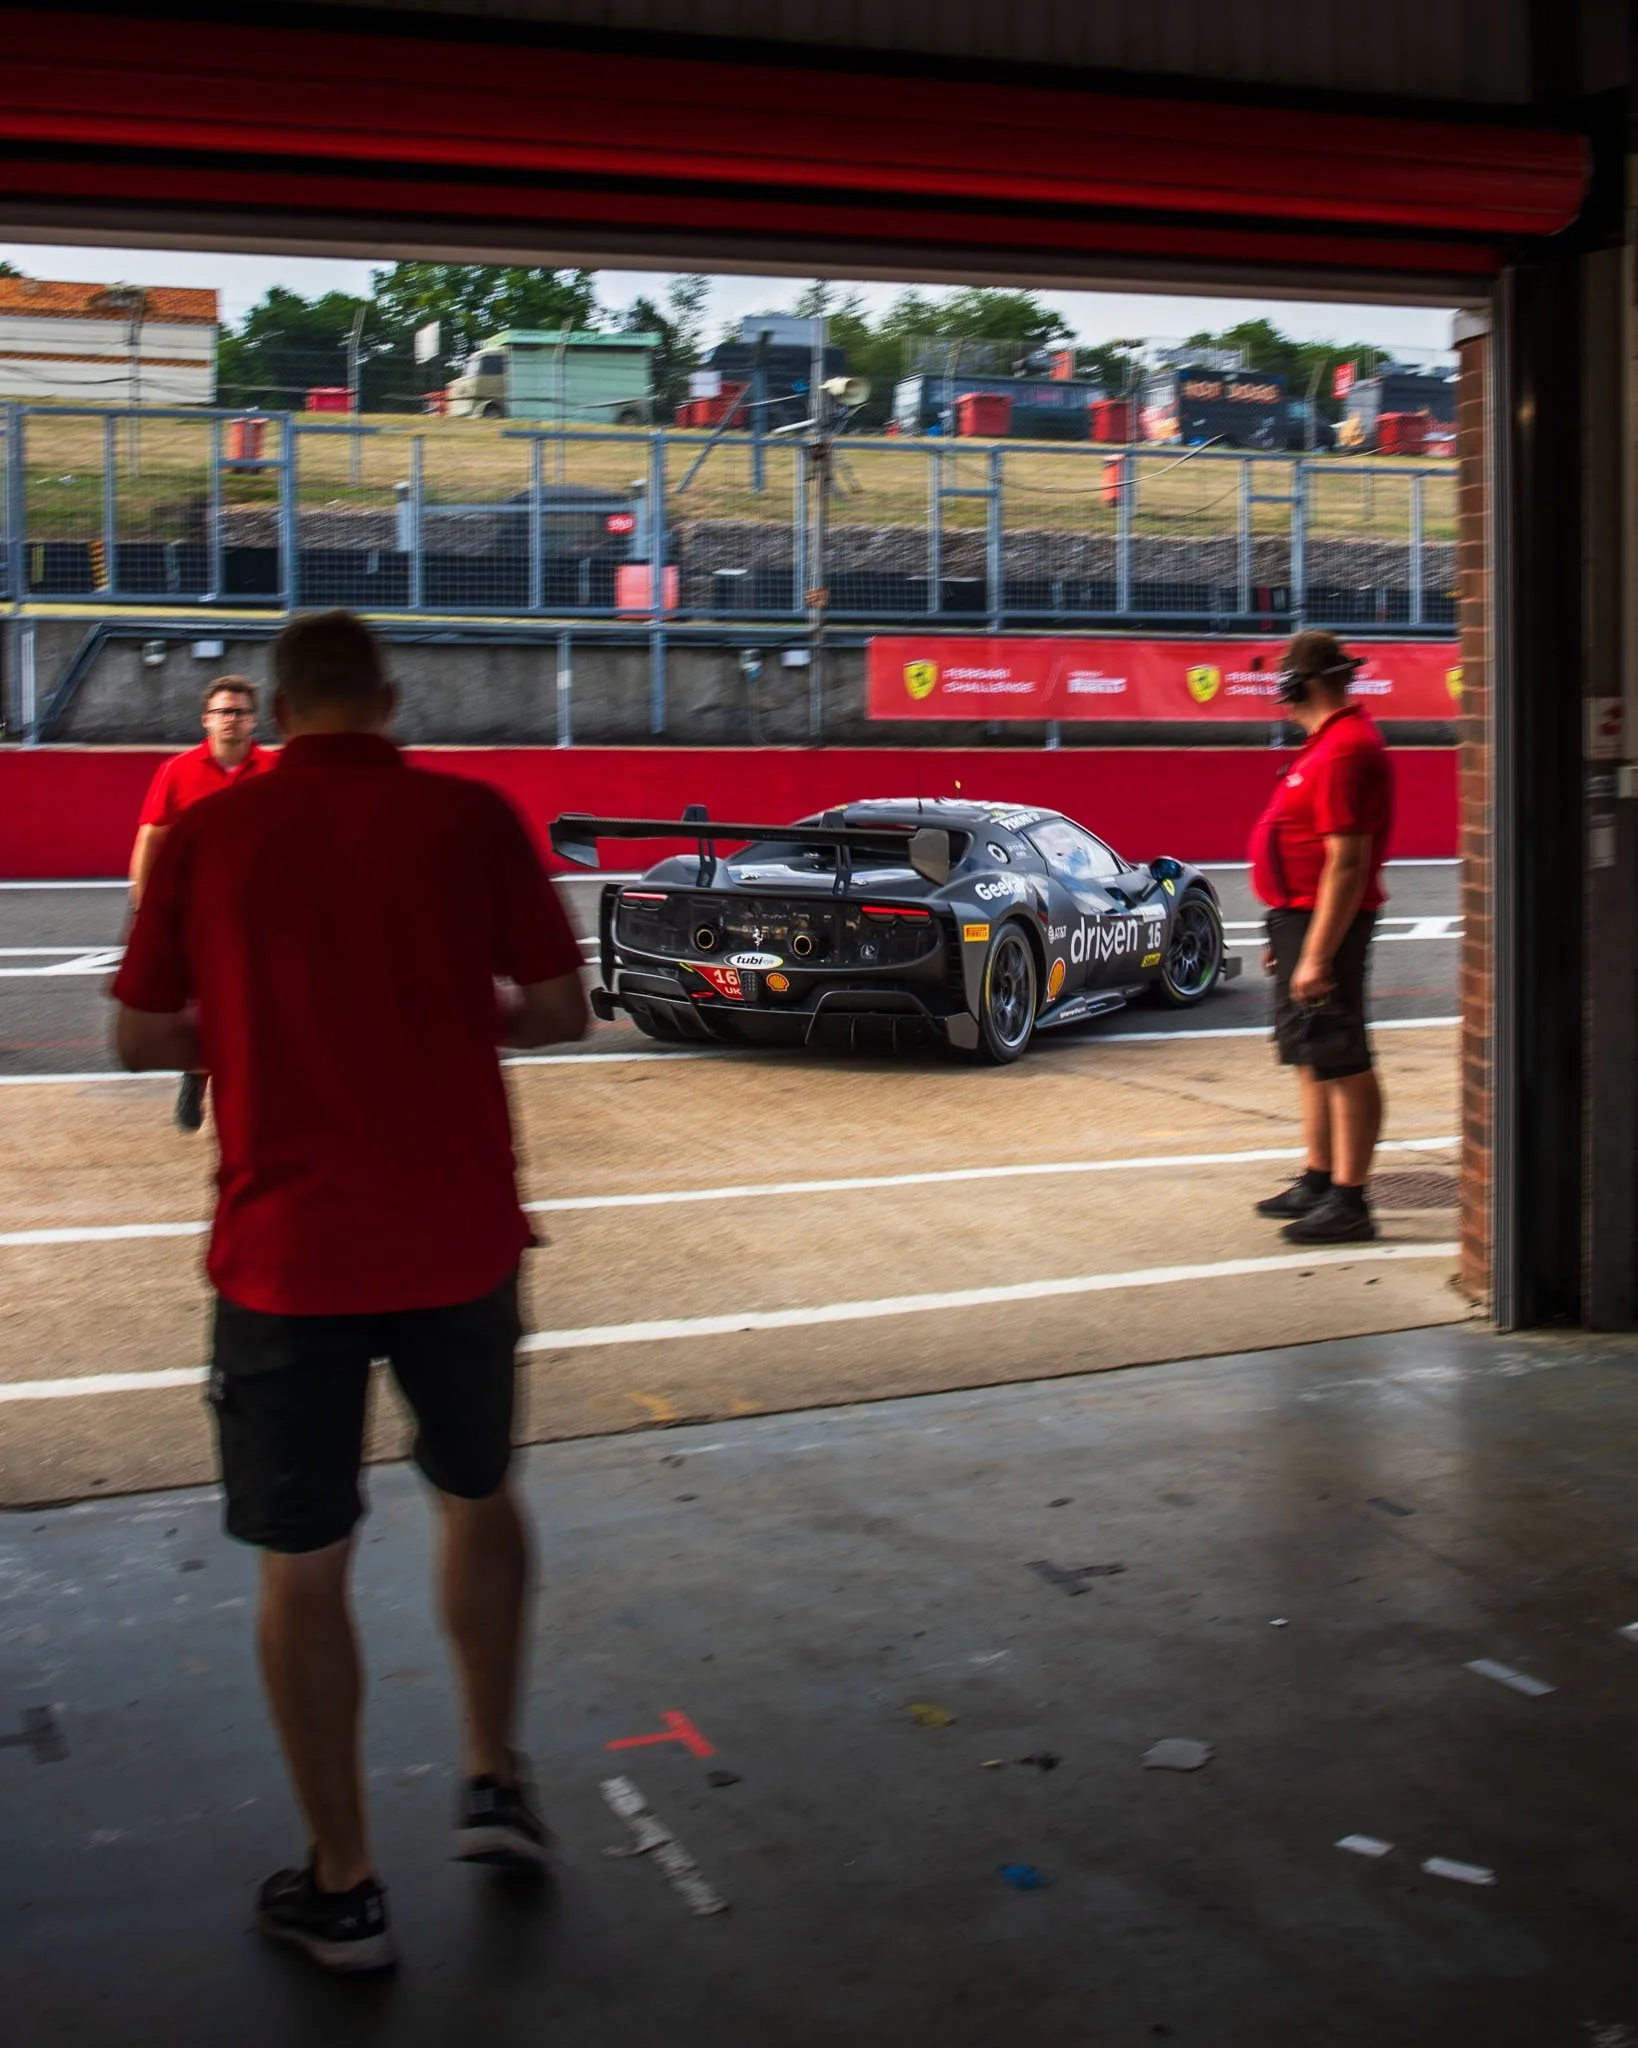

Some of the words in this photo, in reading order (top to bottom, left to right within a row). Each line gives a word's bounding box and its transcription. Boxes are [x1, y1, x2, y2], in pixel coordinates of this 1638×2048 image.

[1070, 914, 1138, 964] driven
[1147, 922, 1161, 949] 16
[736, 955, 764, 965] tubi
[713, 969, 738, 985] 16
[724, 986, 742, 995] UK
